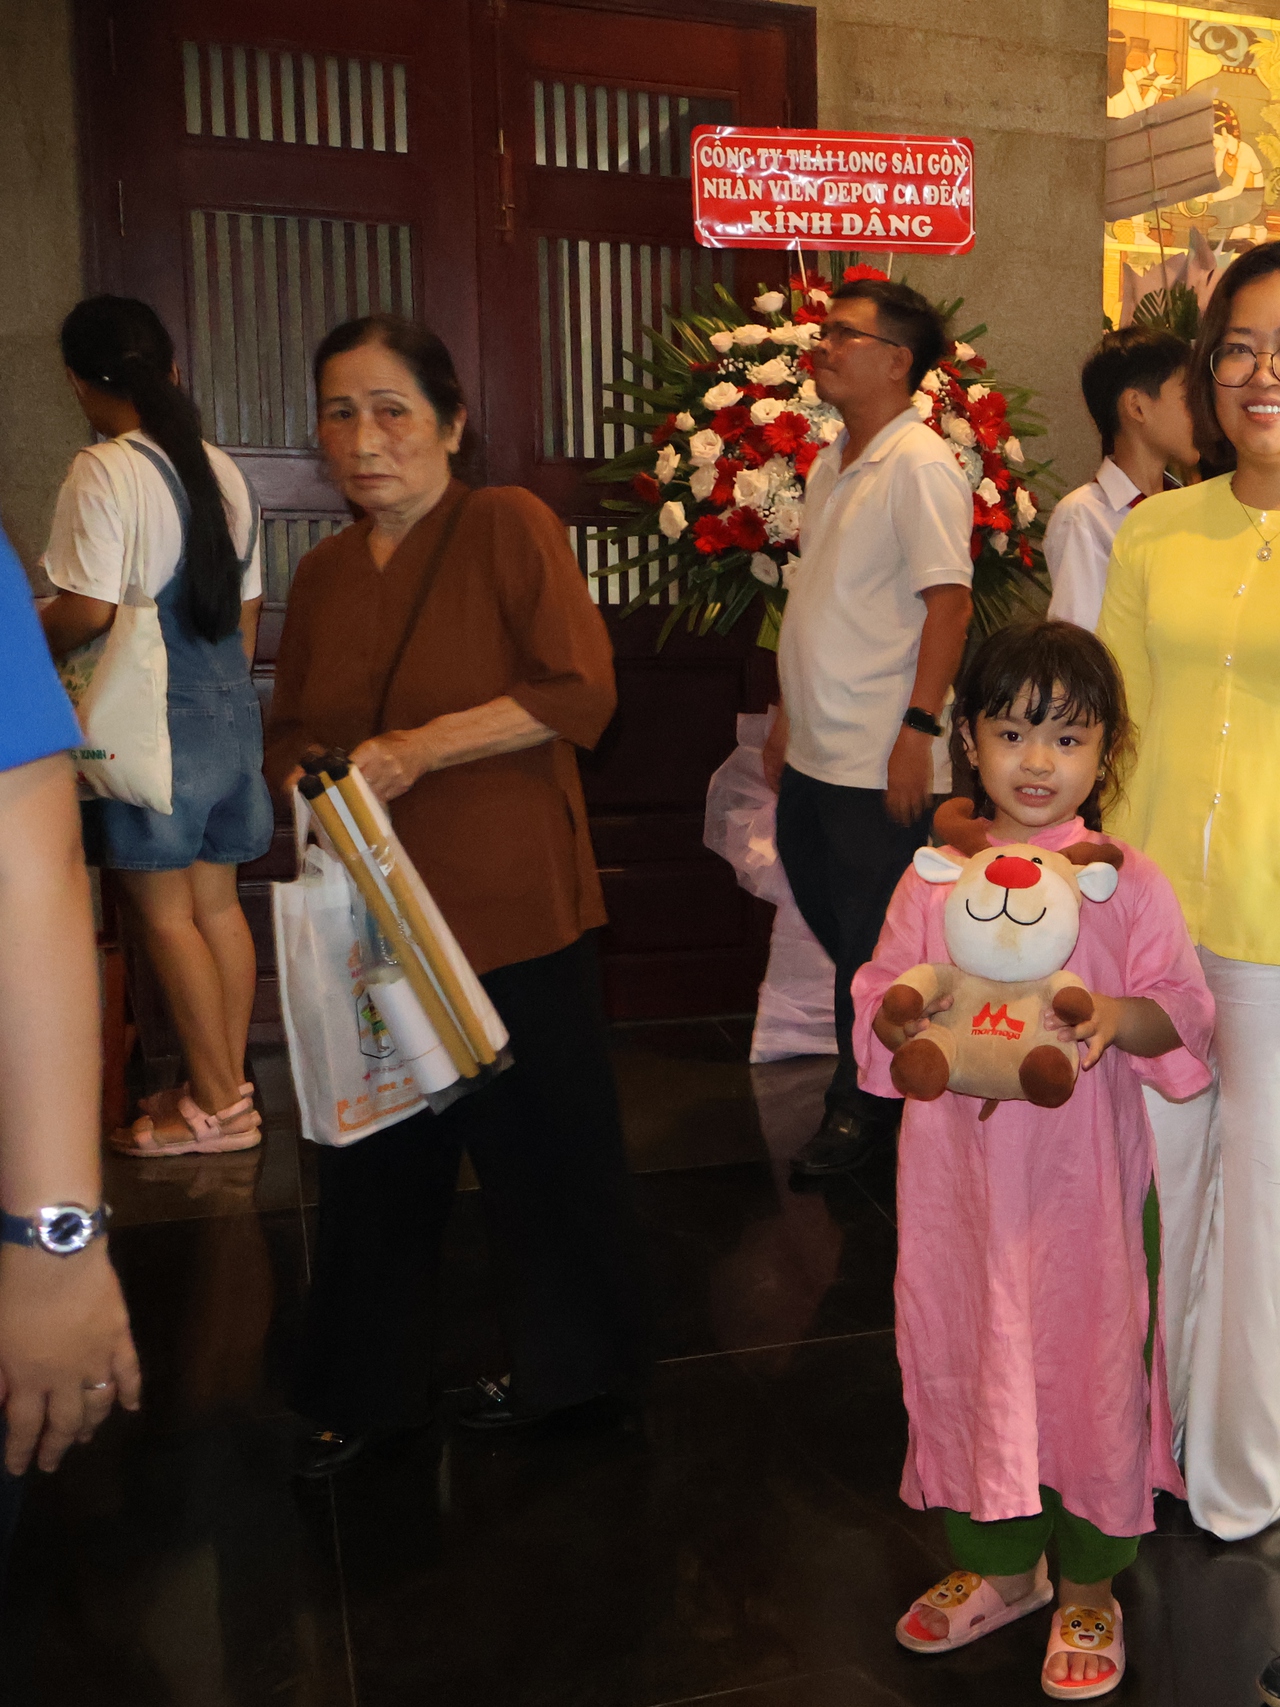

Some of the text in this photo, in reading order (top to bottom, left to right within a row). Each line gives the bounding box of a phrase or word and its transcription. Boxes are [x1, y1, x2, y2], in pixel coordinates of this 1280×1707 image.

[700, 140, 969, 176] CÔNG TY THÁI LONG SÀI GÒN
[702, 171, 763, 200] NHÂN
[823, 181, 889, 204] DEPOT
[893, 183, 921, 205] CA
[923, 179, 970, 207] ĐÊM
[750, 204, 934, 238] KÍNH DÂNG
